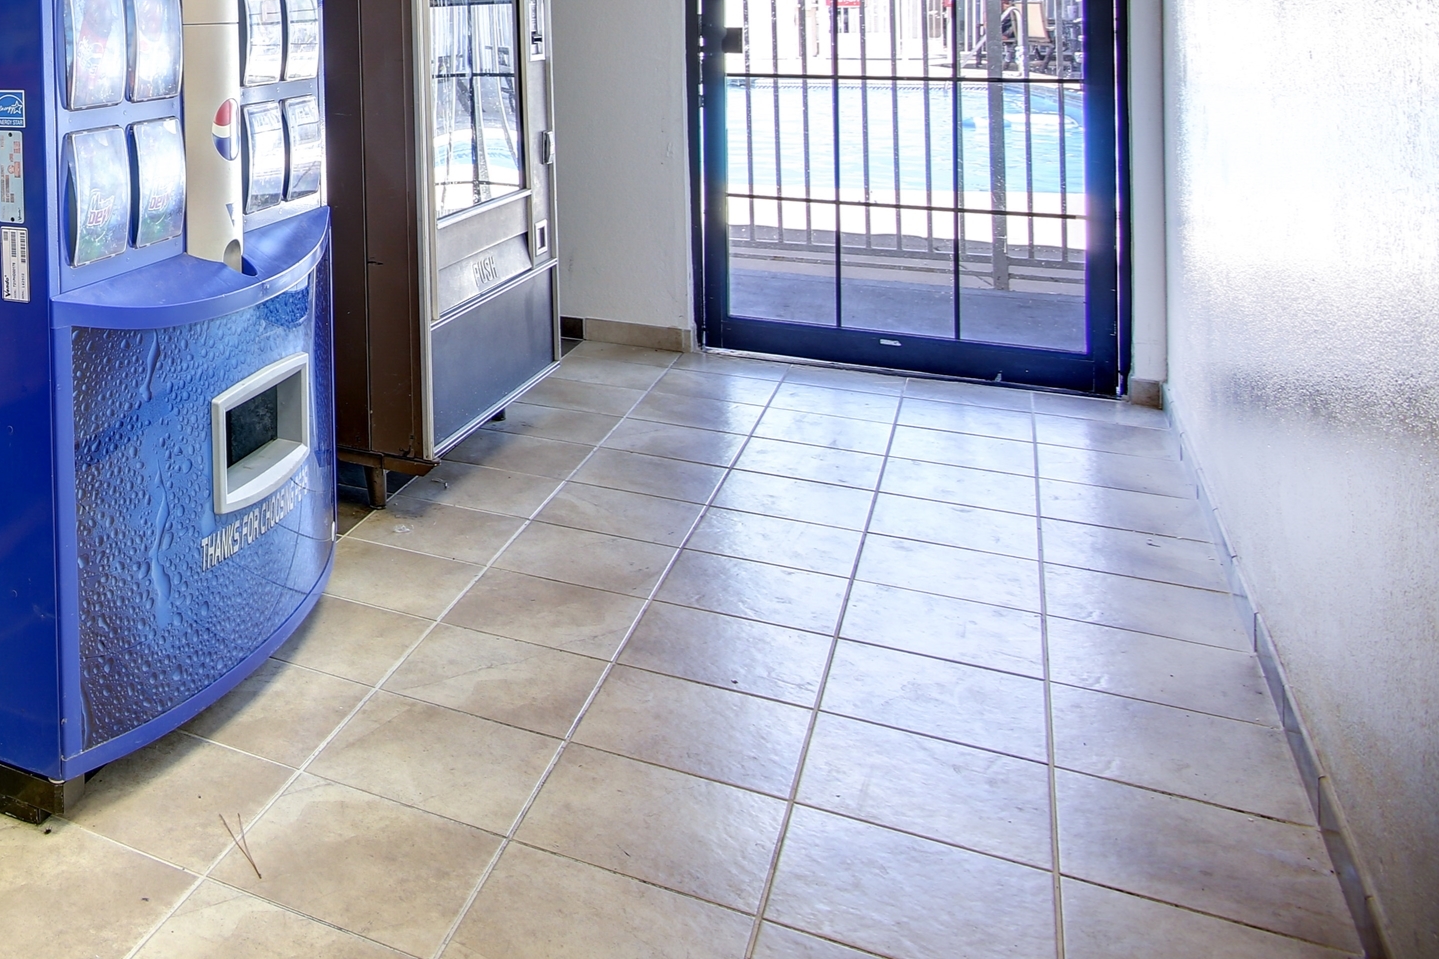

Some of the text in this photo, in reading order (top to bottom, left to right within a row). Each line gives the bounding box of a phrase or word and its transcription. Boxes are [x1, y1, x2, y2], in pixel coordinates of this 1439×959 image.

[472, 256, 498, 287] PUSH
[201, 520, 240, 572] THANKS
[241, 508, 259, 550] FOR
